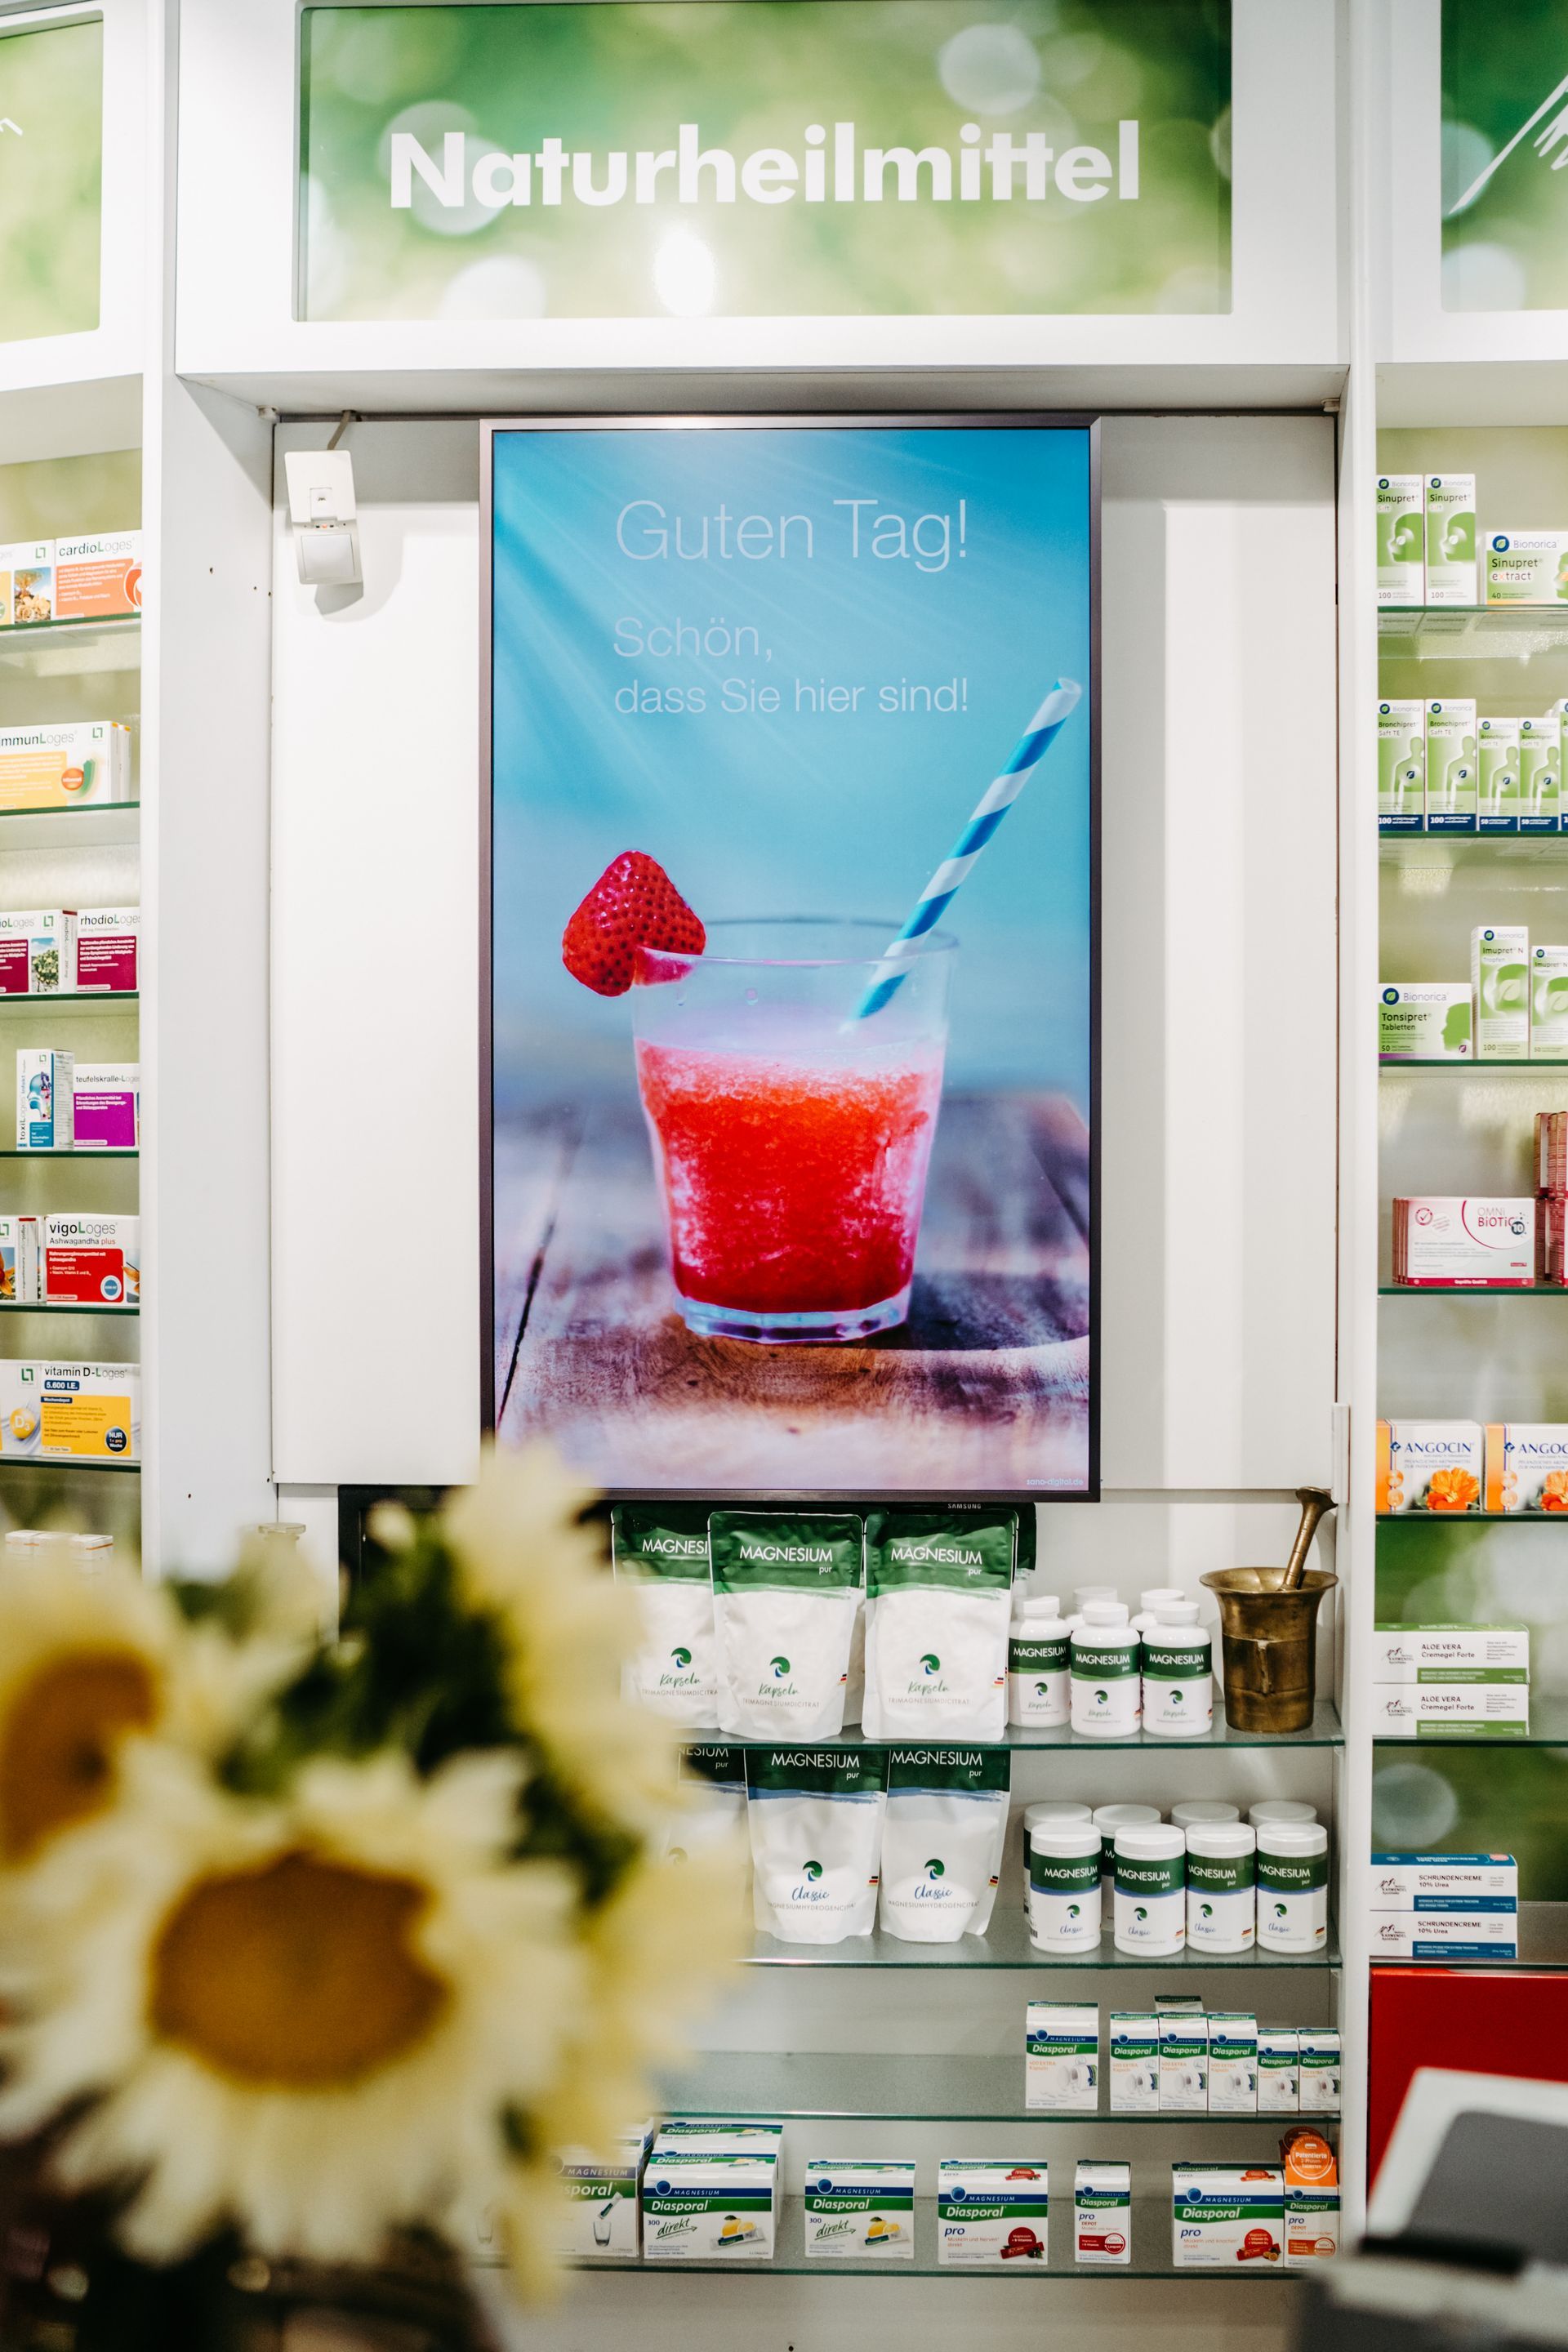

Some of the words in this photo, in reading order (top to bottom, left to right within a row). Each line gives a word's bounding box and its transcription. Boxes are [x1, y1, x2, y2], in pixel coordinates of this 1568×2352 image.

[390, 120, 1140, 208] Naturheilmittel
[1378, 494, 1415, 504] Sinupret
[1430, 493, 1468, 503] Sinupret
[617, 500, 814, 560] Guten
[833, 499, 967, 572] Tag!
[59, 540, 133, 557] cardioLoges
[1513, 540, 1557, 548] Bionorica
[1491, 558, 1539, 570] Sinupret
[1492, 572, 1531, 581] extract
[613, 617, 773, 662] Schön,
[615, 679, 707, 713] dass
[721, 678, 781, 712] Sie
[795, 678, 866, 712] hier
[878, 677, 969, 712] sind!
[1403, 992, 1447, 1001] Bionorica
[1381, 1013, 1428, 1023] Tonsipret
[49, 1221, 116, 1237] vigoLoges
[49, 1237, 99, 1246] Ashwagandha
[100, 1237, 116, 1245] plus
[45, 1366, 81, 1377] vitamin
[46, 1381, 65, 1389] 5.600
[1405, 1442, 1472, 1453] ANGOCIN
[1027, 1477, 1084, 1486] sano-digital.de
[740, 1545, 833, 1563] MAGNESIUM
[891, 1547, 982, 1565] MAGNESIUM
[968, 1568, 982, 1576] pur
[1013, 1646, 1067, 1658] MAGNESIUM
[1076, 1653, 1130, 1664] MAGNESIUM
[1149, 1654, 1205, 1664] MAGNESIUM
[659, 1672, 702, 1688] Kapseln
[758, 1682, 800, 1698] Kapseln
[907, 1679, 951, 1696] Kapseln
[888, 1697, 970, 1706] TRIMAGNESIUMDICITRAT
[771, 1753, 860, 1768] MAGNESIUM
[891, 1750, 982, 1766] MAGNESIUM
[715, 1761, 728, 1770] pur
[846, 1771, 860, 1780] pur
[969, 1769, 982, 1778] pur
[1045, 1865, 1098, 1878] MAGNESIUM
[1117, 1866, 1170, 1882] MAGNESIUM
[1258, 1863, 1311, 1878] MAGNESIUM
[791, 1886, 830, 1902] Classic
[914, 1884, 953, 1900] Classic
[1032, 2044, 1077, 2055] Diasporal
[1114, 2047, 1152, 2056] Diasporal
[1163, 2046, 1200, 2055] Diasporal
[1212, 2047, 1250, 2056] Diasporal
[568, 2168, 628, 2176] MAGNESIUM
[651, 2199, 709, 2213] Diasporal
[813, 2198, 870, 2212] Diasporal
[1080, 2198, 1119, 2207] Diasporal
[1290, 2203, 1329, 2211] Diasporal
[947, 2205, 1004, 2219] Diasporal
[1183, 2207, 1241, 2221] Diasporal
[1288, 2216, 1305, 2225] pro
[657, 2217, 690, 2236] direkt
[816, 2220, 849, 2237] direkt
[944, 2228, 965, 2237] pro
[1180, 2229, 1201, 2238] pro
